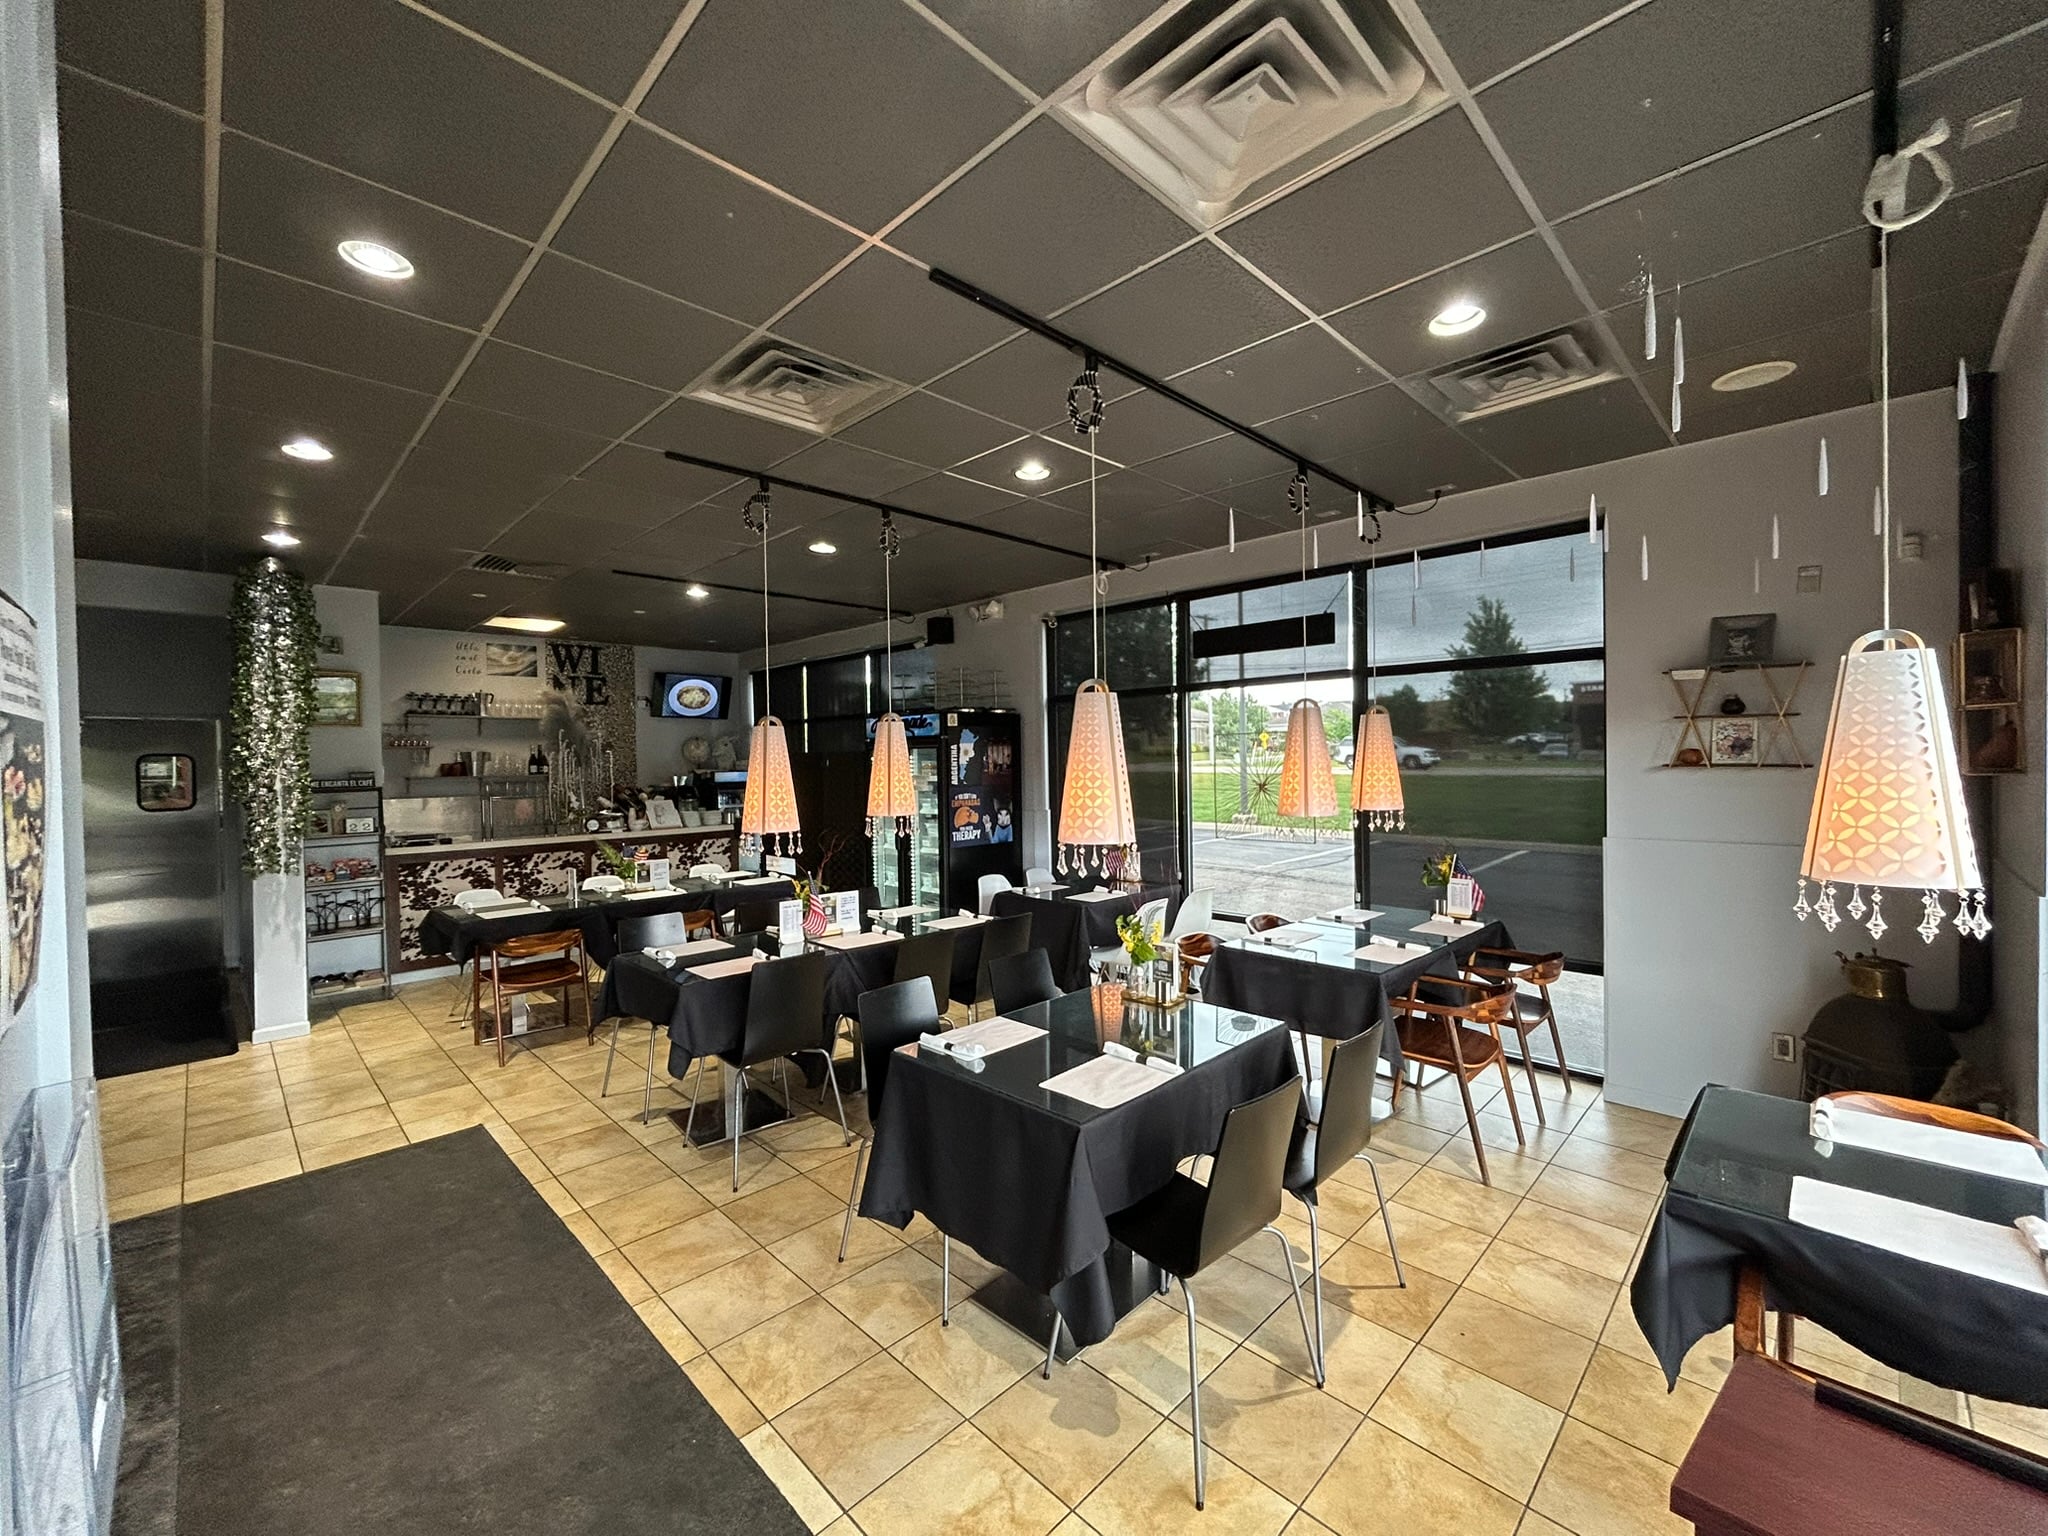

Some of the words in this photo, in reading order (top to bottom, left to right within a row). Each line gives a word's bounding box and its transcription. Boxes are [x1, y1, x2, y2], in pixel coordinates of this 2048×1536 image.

[548, 643, 603, 675] WI
[548, 674, 609, 706] NE
[950, 744, 958, 785] ARGENTINA
[952, 829, 981, 841] THERAPY
